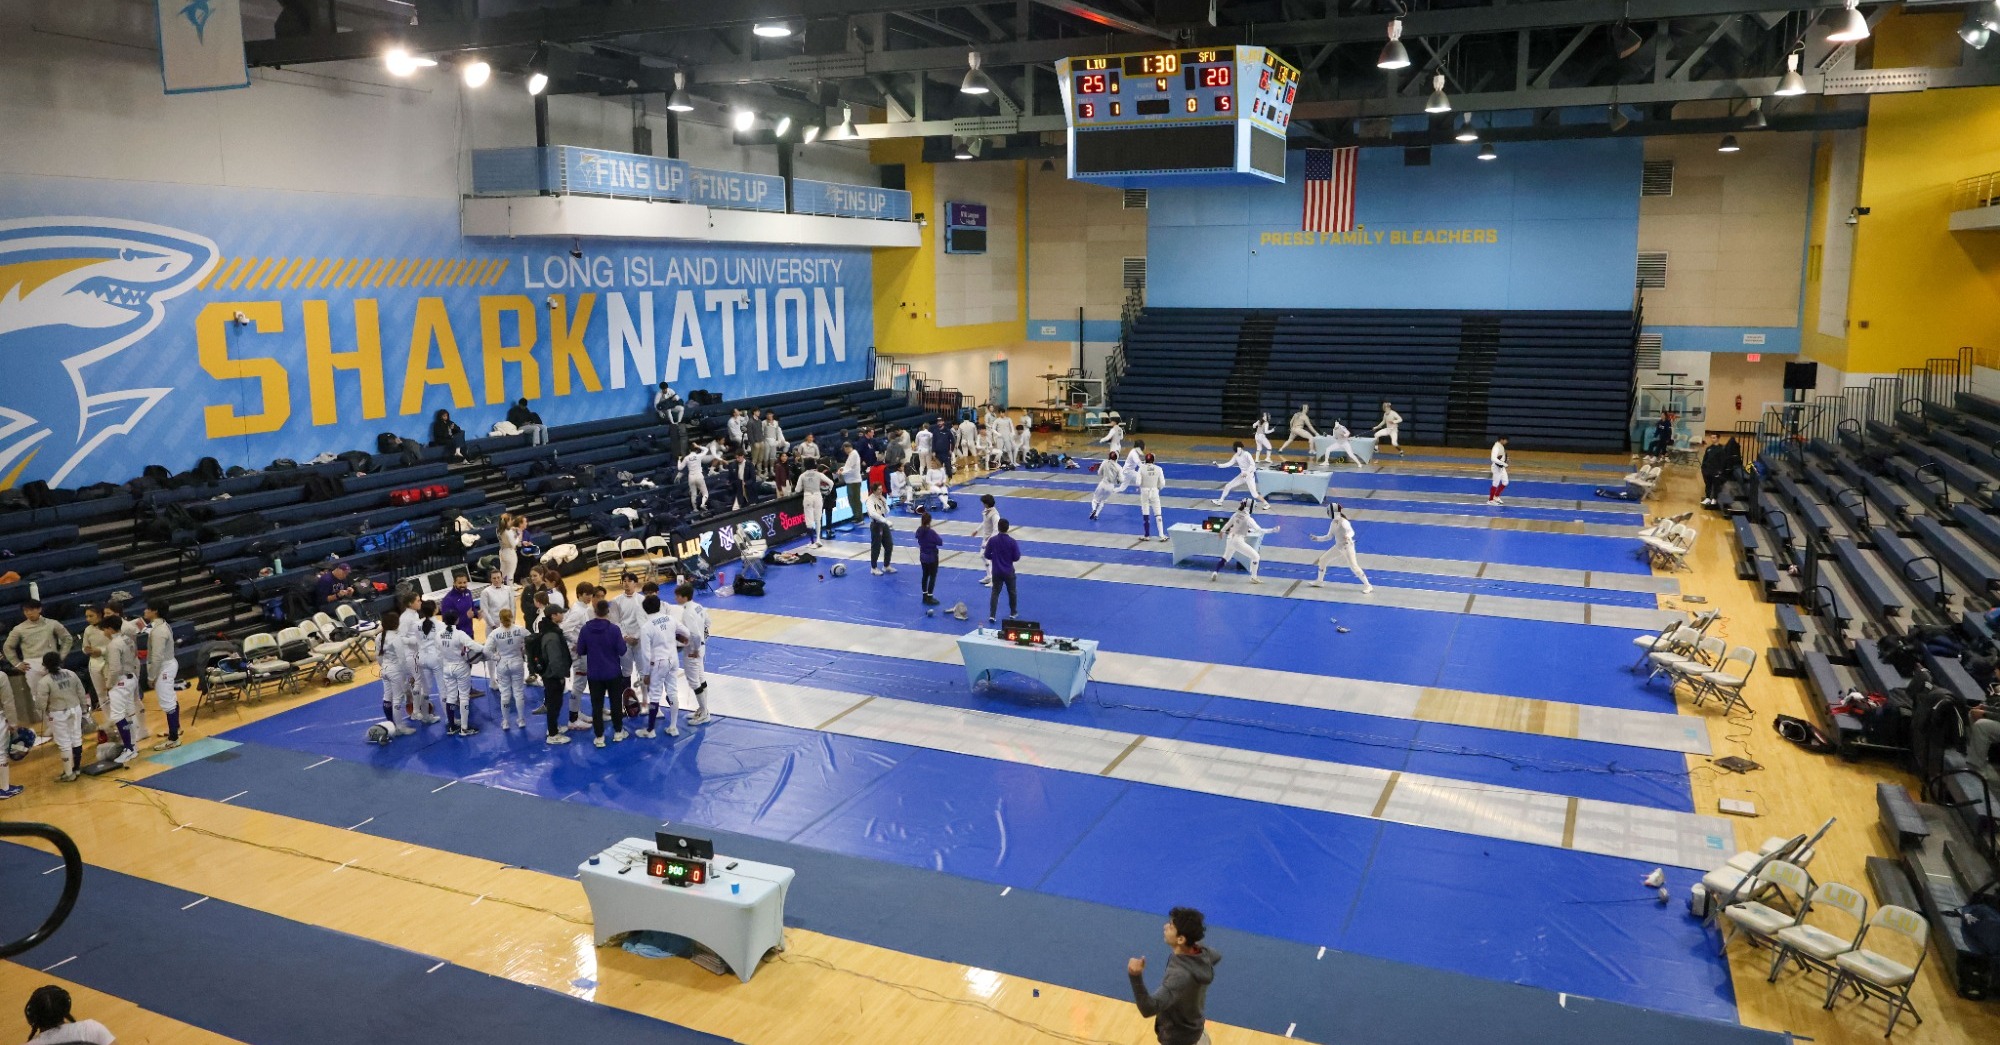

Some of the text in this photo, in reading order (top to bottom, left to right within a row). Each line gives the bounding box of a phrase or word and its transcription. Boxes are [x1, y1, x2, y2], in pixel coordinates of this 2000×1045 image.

[1086, 58, 1107, 70] LIU
[1143, 54, 1177, 73] 1:30
[1198, 51, 1216, 63] SFU
[1083, 75, 1104, 93] 25
[1157, 79, 1166, 90] 4
[1206, 67, 1229, 86] 20
[1085, 104, 1093, 117] 3
[1115, 103, 1120, 115] 1
[1187, 98, 1197, 112] 0
[1221, 97, 1230, 110] 5
[595, 157, 685, 192] FINS UP
[699, 173, 768, 204] FINS UP
[835, 188, 886, 213] FINS UP
[1260, 228, 1498, 246] PRESS FAMILY BLEACHERS
[523, 255, 843, 289] LONG ISLAND UNIVERSITY
[677, 537, 702, 559] LIU
[656, 865, 663, 875] 0
[693, 871, 700, 881] 0
[1823, 884, 1858, 909] LIU
